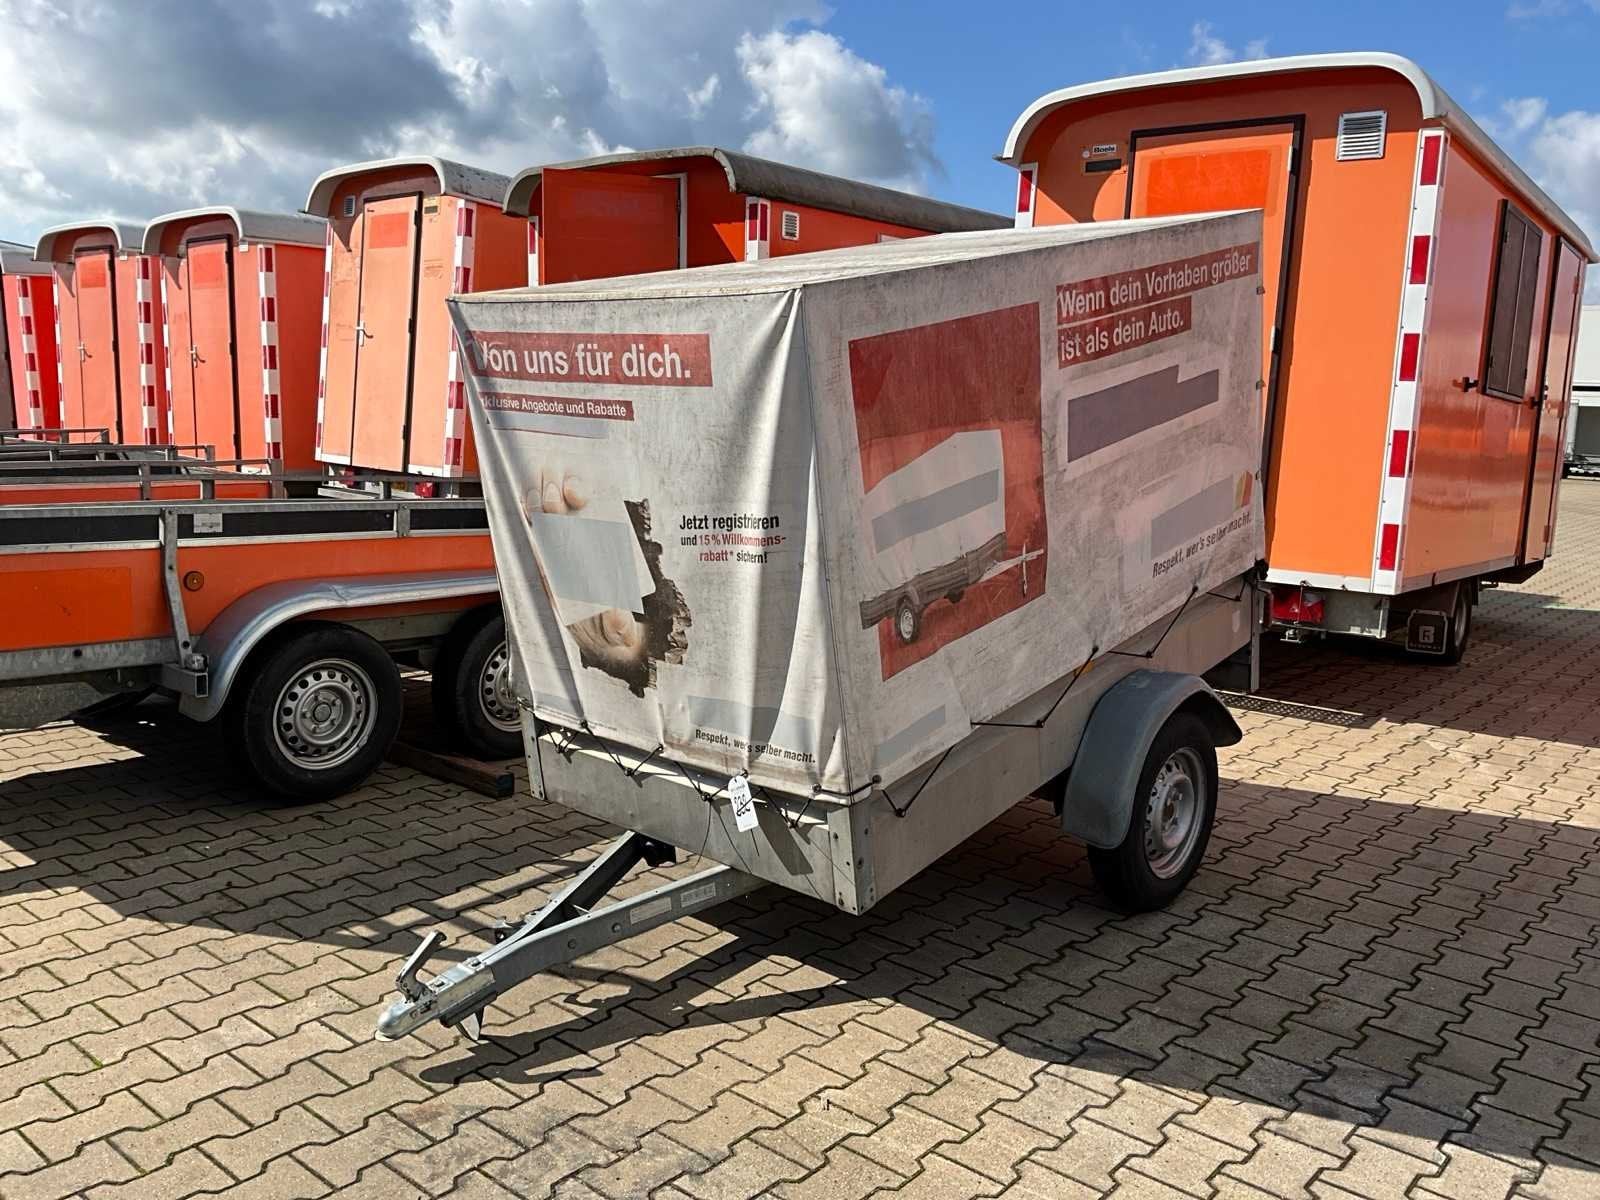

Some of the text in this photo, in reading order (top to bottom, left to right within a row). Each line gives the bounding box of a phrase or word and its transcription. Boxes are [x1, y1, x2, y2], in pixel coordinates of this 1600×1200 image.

[1059, 252, 1252, 318] Wenn dein Vorhaben größer
[1060, 311, 1184, 361] ist als dein Auto.
[524, 349, 569, 376] uns
[575, 343, 613, 377] für
[621, 343, 692, 380] dich.
[521, 398, 564, 416] Angebote
[566, 402, 585, 415] und
[587, 402, 627, 417] Rabatte
[680, 513, 780, 532] Jetzt registrieren
[681, 532, 787, 548] und 15 % Willkommens-
[736, 551, 768, 564] sichern!
[1152, 511, 1252, 578] Respekt, wer's selber macht.
[695, 729, 731, 748] Respekt,
[755, 742, 782, 757] selber
[783, 749, 816, 764] macht.
